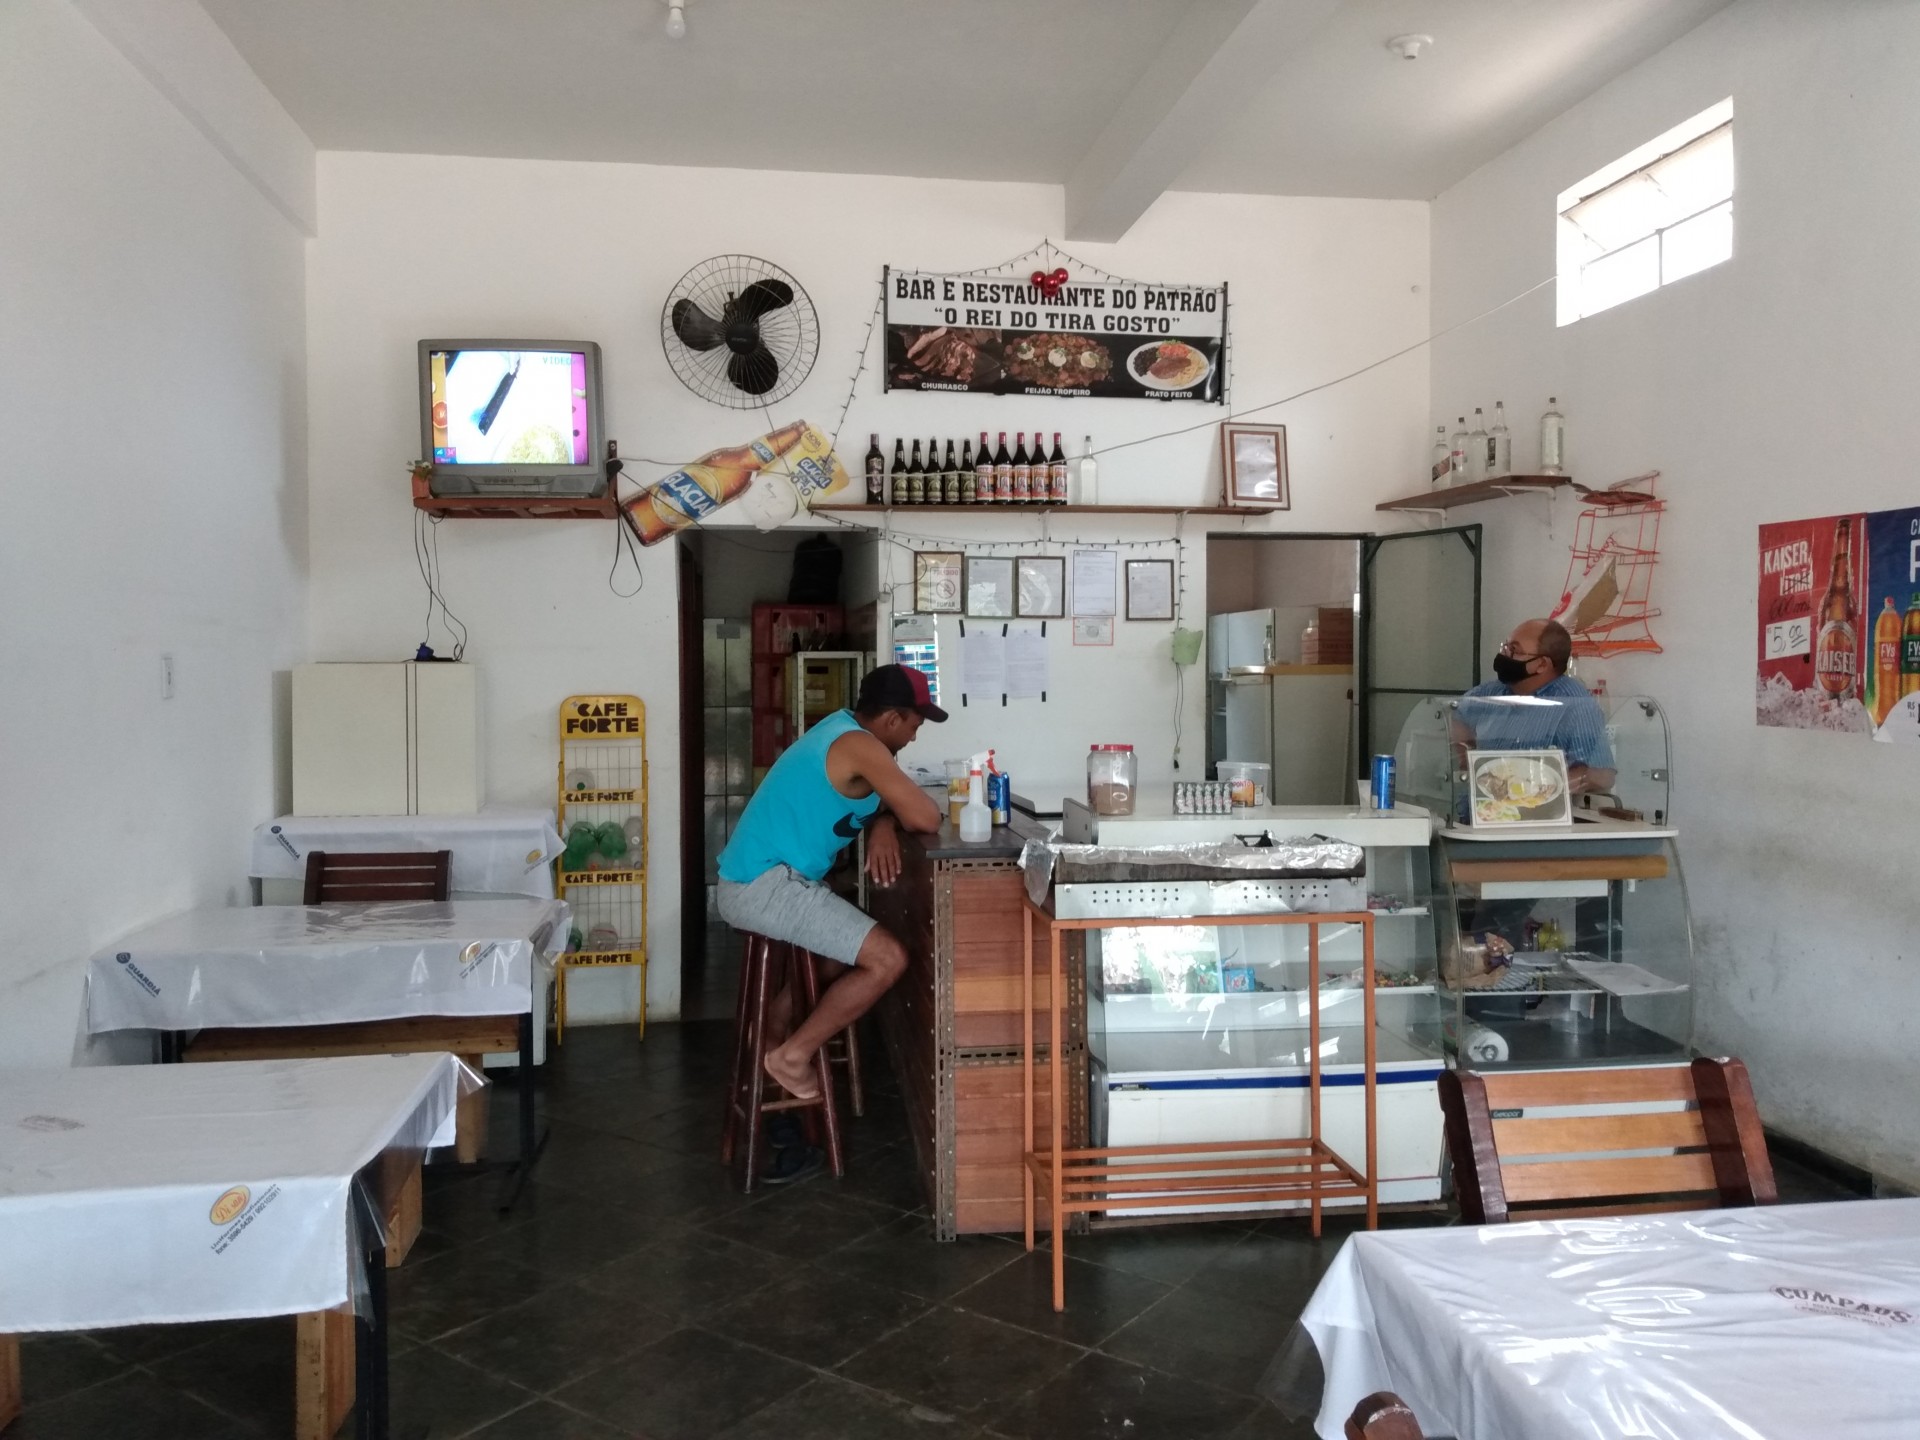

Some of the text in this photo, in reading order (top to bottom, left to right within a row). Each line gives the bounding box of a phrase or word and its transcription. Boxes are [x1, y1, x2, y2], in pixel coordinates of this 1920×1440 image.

[896, 278, 935, 300] BAR
[943, 281, 955, 301] E
[1112, 289, 1137, 310] DO
[1144, 287, 1217, 313] PATRÃO
[966, 309, 1001, 327] REI
[1010, 311, 1037, 328] DO
[1045, 312, 1096, 331] TIRA
[921, 382, 969, 391] CHURRASCO
[1025, 386, 1091, 396] FEIJÃO TROPEIRO
[1170, 391, 1193, 399] FEITO
[663, 471, 717, 517] GLACIAL
[1764, 540, 1808, 575] KAISER
[1816, 651, 1856, 675] KAISER
[566, 717, 639, 734] FORTE
[597, 791, 634, 802] FORTE
[597, 872, 633, 882] FORTE
[596, 953, 632, 963] FORTE
